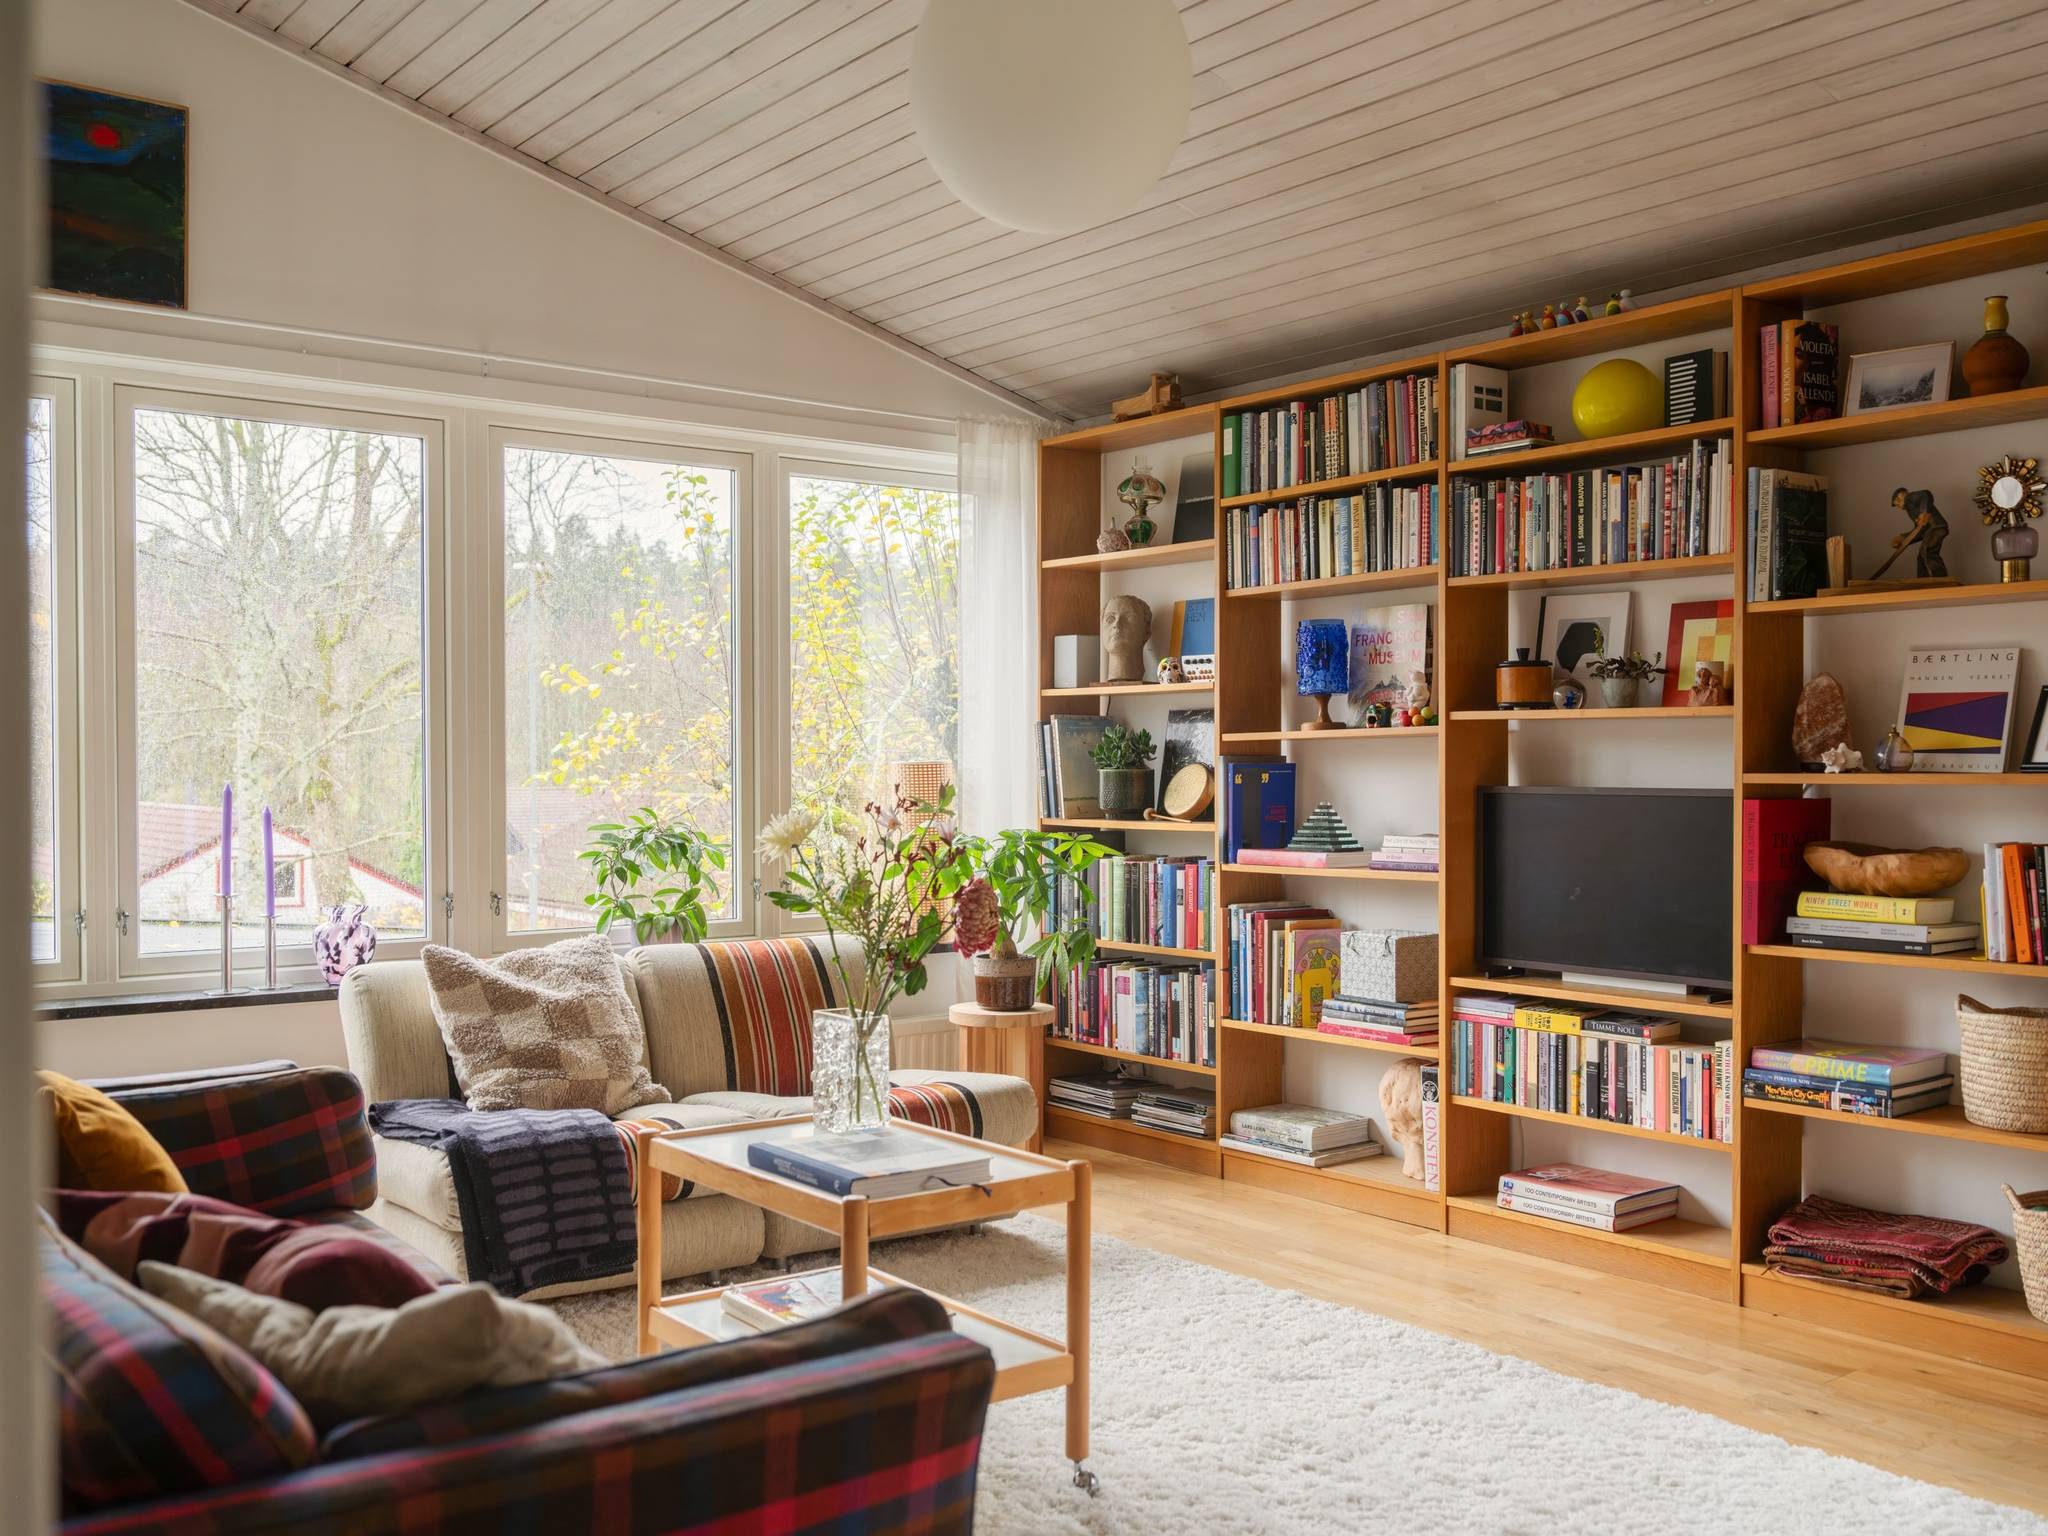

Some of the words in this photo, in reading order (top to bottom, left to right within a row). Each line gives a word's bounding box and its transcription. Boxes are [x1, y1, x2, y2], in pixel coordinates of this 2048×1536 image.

[1799, 340, 1834, 356] VIOLETA
[1783, 367, 1792, 404] VIOLETA
[1803, 371, 1831, 386] ISABEL
[1797, 386, 1836, 402] ALLENDE
[1577, 475, 1585, 507] BEAUVOIR
[1577, 515, 1585, 540] SIMONE
[1355, 630, 1422, 648] FRANCISCO
[1911, 652, 2015, 664] BÆRTLING
[1805, 896, 1825, 905] NINTH
[1827, 898, 1851, 908] STREET
[1853, 900, 1879, 910] WOMEN
[1231, 966, 1239, 994] PICASSO
[1591, 1022, 1615, 1033] TIMME
[1617, 1024, 1636, 1035] NOLL
[1715, 1046, 1723, 1067] ETHAN
[1715, 1068, 1723, 1090] HAWKE
[1804, 1057, 1868, 1083] PRIME
[1765, 1084, 1776, 1094] New
[1776, 1086, 1793, 1098] York
[1793, 1089, 1807, 1100] City
[1424, 1105, 1438, 1185] KONSTEN
[1524, 1186, 1535, 1195] 100
[1535, 1188, 1576, 1205] CONTEMPORARY
[1576, 1198, 1597, 1209] ARTISTS
[1533, 1203, 1574, 1219] CONTEMPORARY
[1575, 1213, 1596, 1224] ARTISTS
